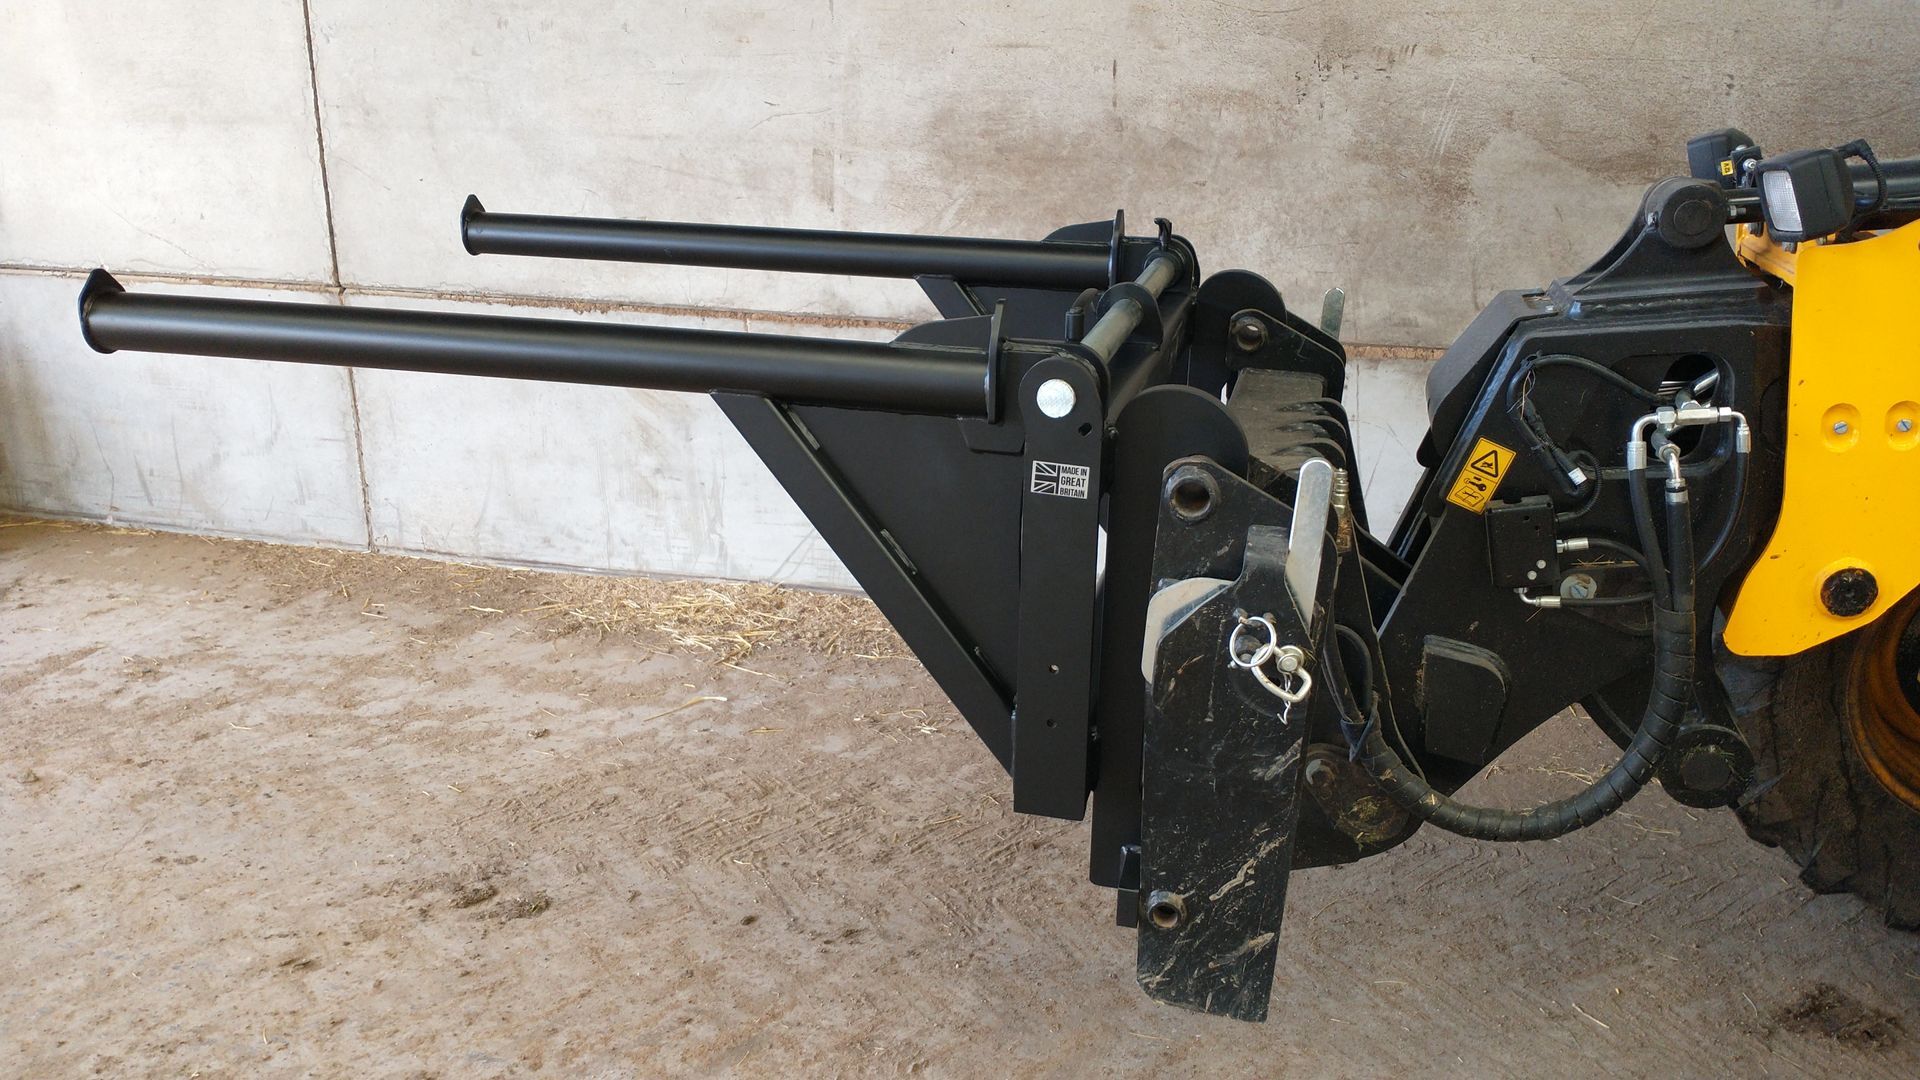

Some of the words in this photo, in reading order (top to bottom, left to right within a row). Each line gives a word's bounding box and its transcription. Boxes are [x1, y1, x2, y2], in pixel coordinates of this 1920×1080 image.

[1061, 466, 1080, 475] MADE
[1080, 468, 1088, 477] IN
[1060, 476, 1086, 488] GREAT
[1060, 488, 1085, 498] BRITAIN
